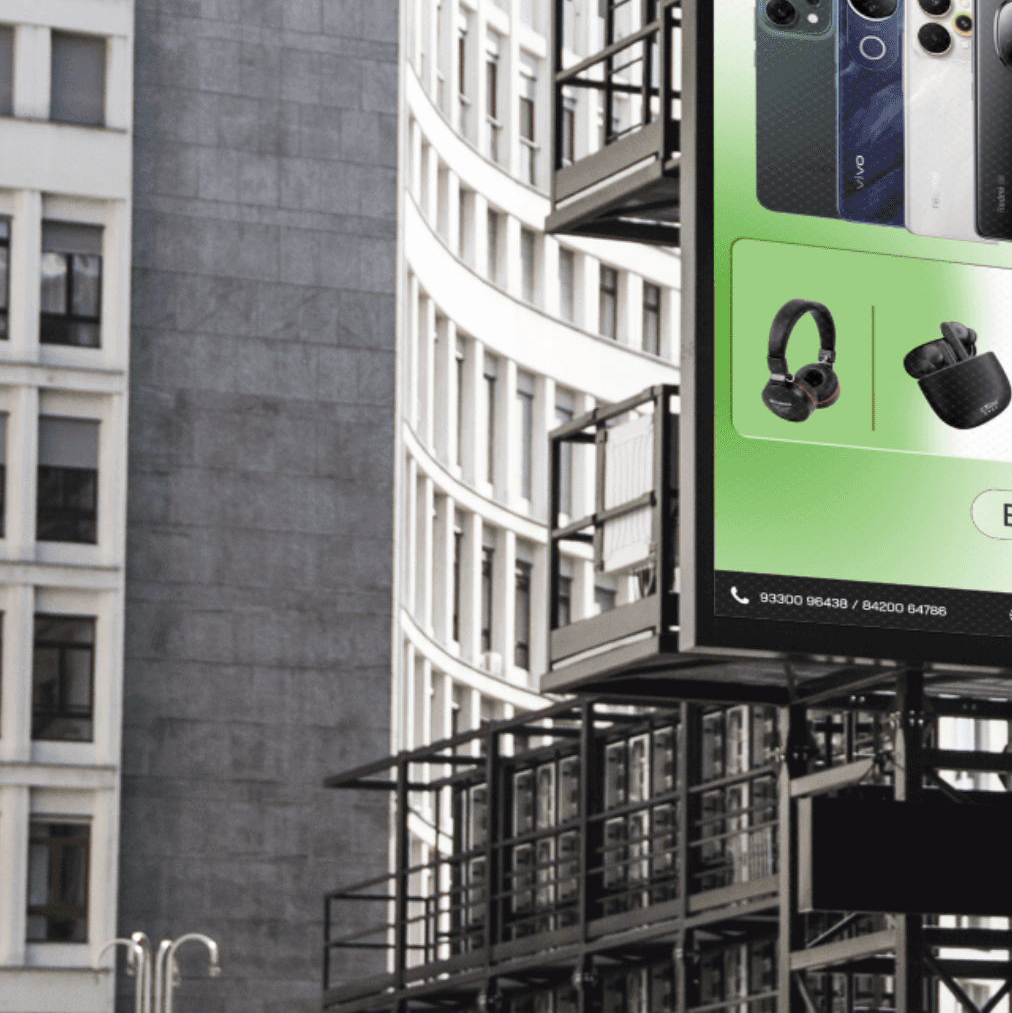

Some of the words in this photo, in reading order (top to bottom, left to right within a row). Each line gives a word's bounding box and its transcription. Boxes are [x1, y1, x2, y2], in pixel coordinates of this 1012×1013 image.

[854, 155, 865, 190] vivo
[760, 591, 803, 606] 93300
[806, 595, 848, 609] 96438
[851, 599, 858, 609] /
[862, 599, 904, 613] 84200
